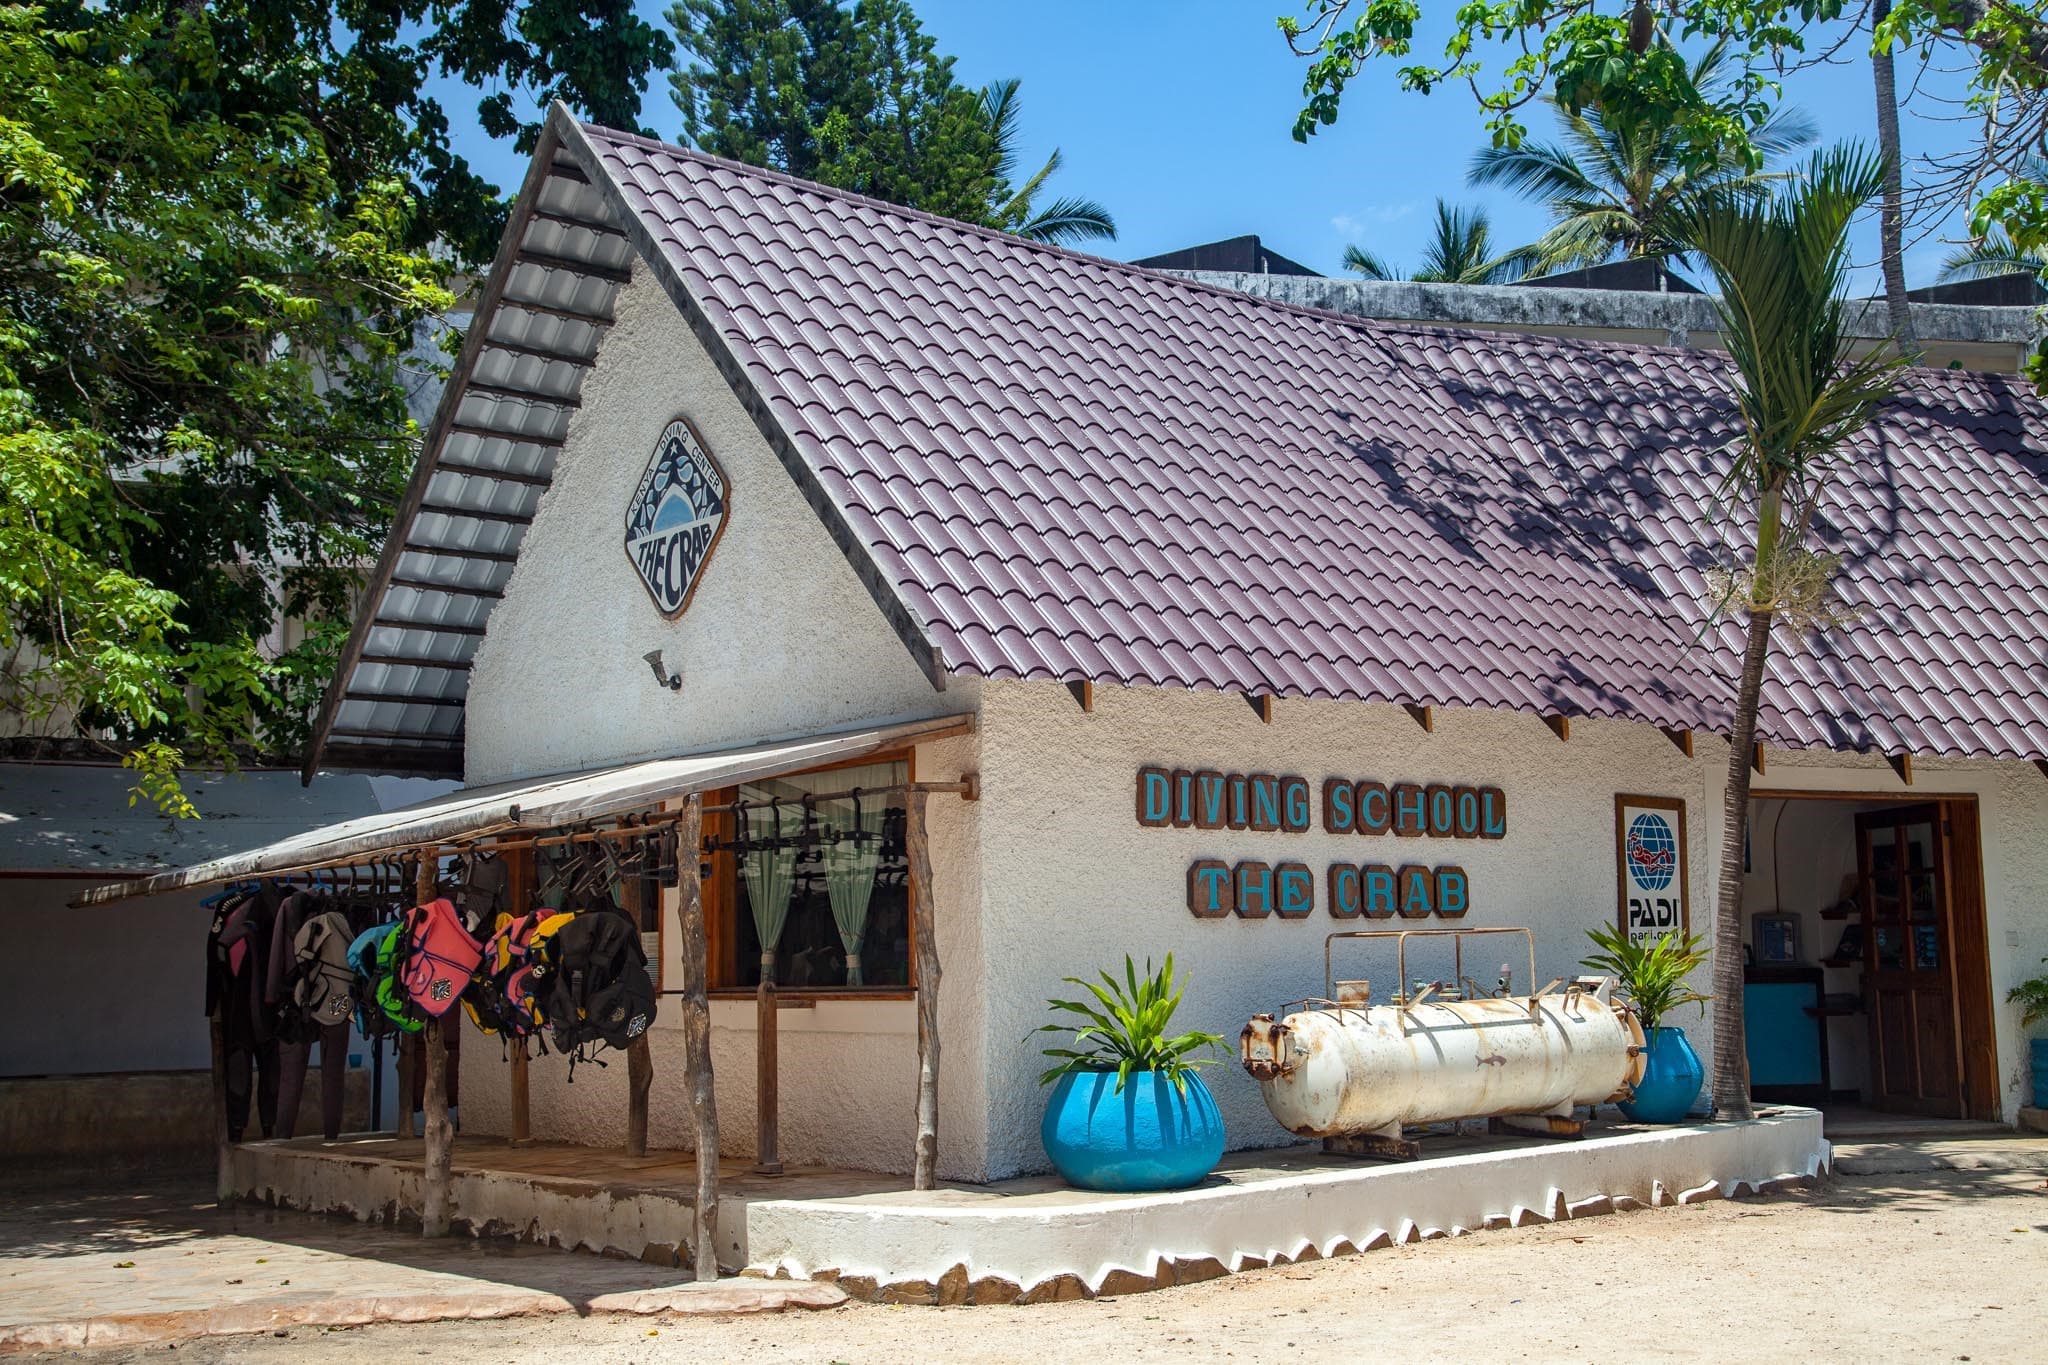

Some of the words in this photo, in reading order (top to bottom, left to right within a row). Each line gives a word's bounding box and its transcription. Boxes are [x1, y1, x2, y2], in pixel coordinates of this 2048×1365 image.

[630, 468, 654, 514] KENYA
[660, 423, 688, 451] DIVING
[692, 446, 720, 491] CENTER
[638, 536, 666, 601] THE
[664, 523, 712, 607] CRAB
[1144, 773, 1309, 827] DIVING
[1333, 785, 1504, 834] SCHOOL
[1197, 868, 1312, 913] THE
[1338, 869, 1468, 913] CRAB
[1629, 898, 1678, 927] PADI
